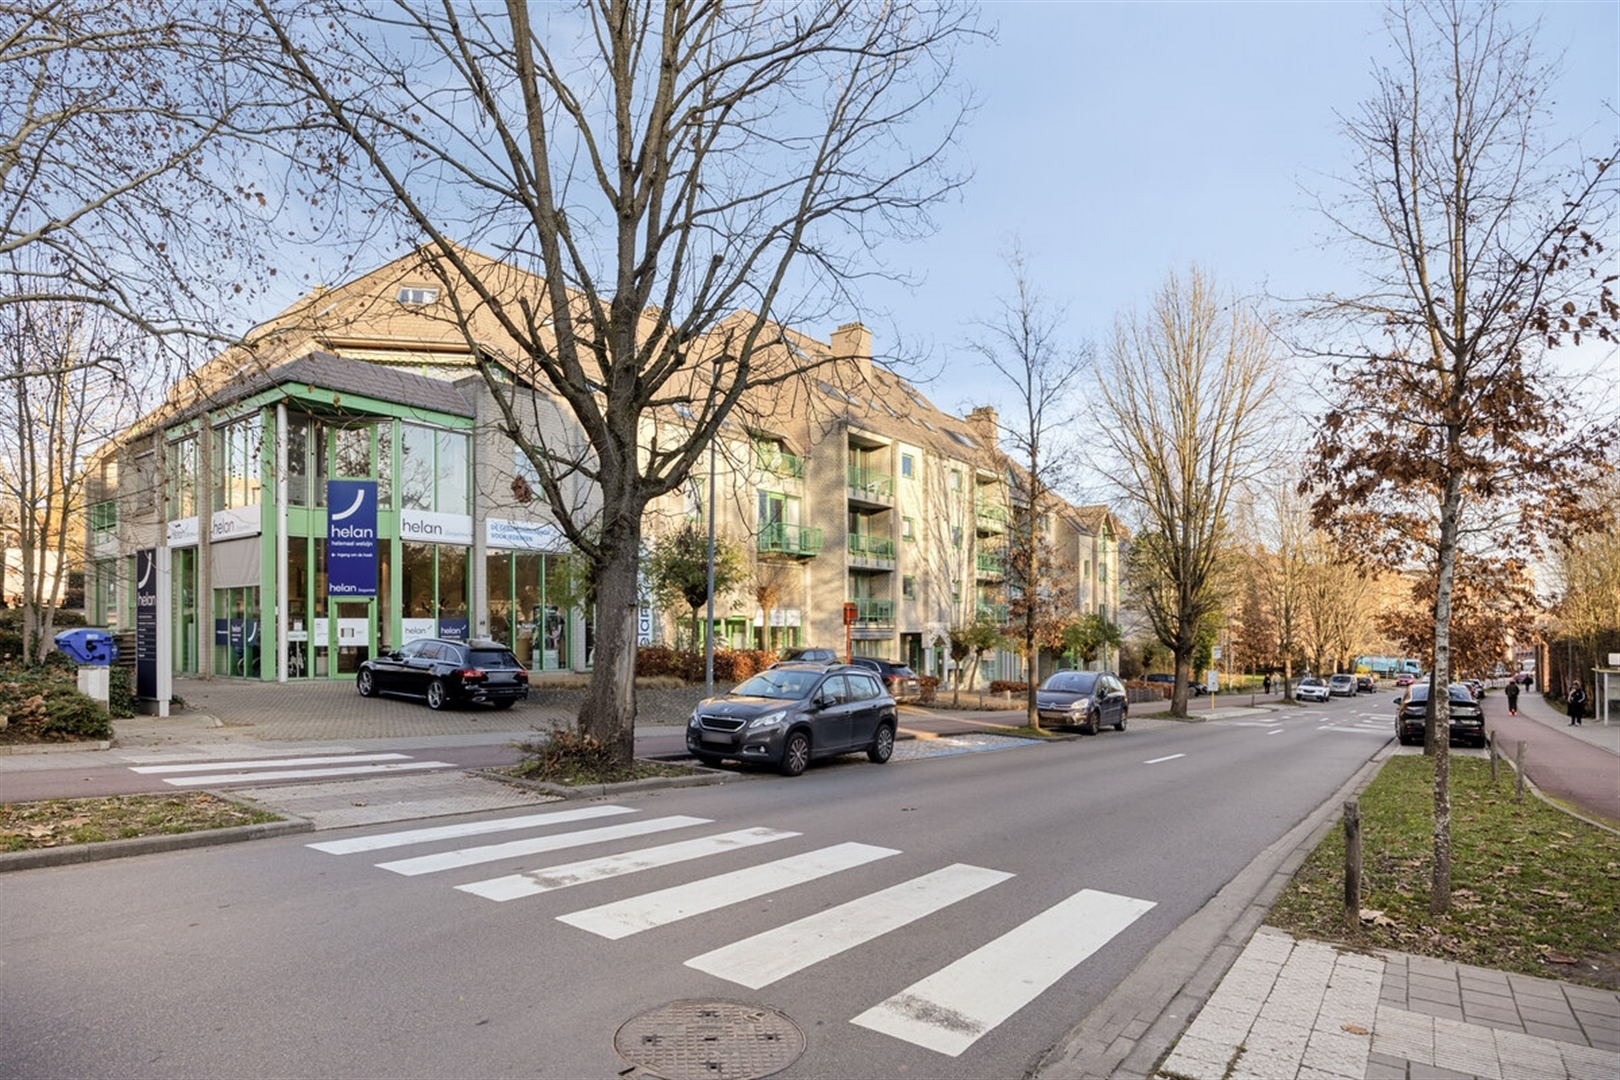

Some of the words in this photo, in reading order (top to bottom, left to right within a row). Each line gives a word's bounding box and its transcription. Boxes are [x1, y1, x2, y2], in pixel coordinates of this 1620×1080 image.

[212, 518, 235, 535] helan
[331, 524, 374, 538] helan
[402, 517, 443, 535] helan
[507, 533, 533, 542] IEDEEN
[329, 582, 357, 592] helan
[138, 591, 156, 606] helan
[405, 626, 427, 635] helan
[440, 626, 461, 635] helan
[638, 607, 650, 647] elan
